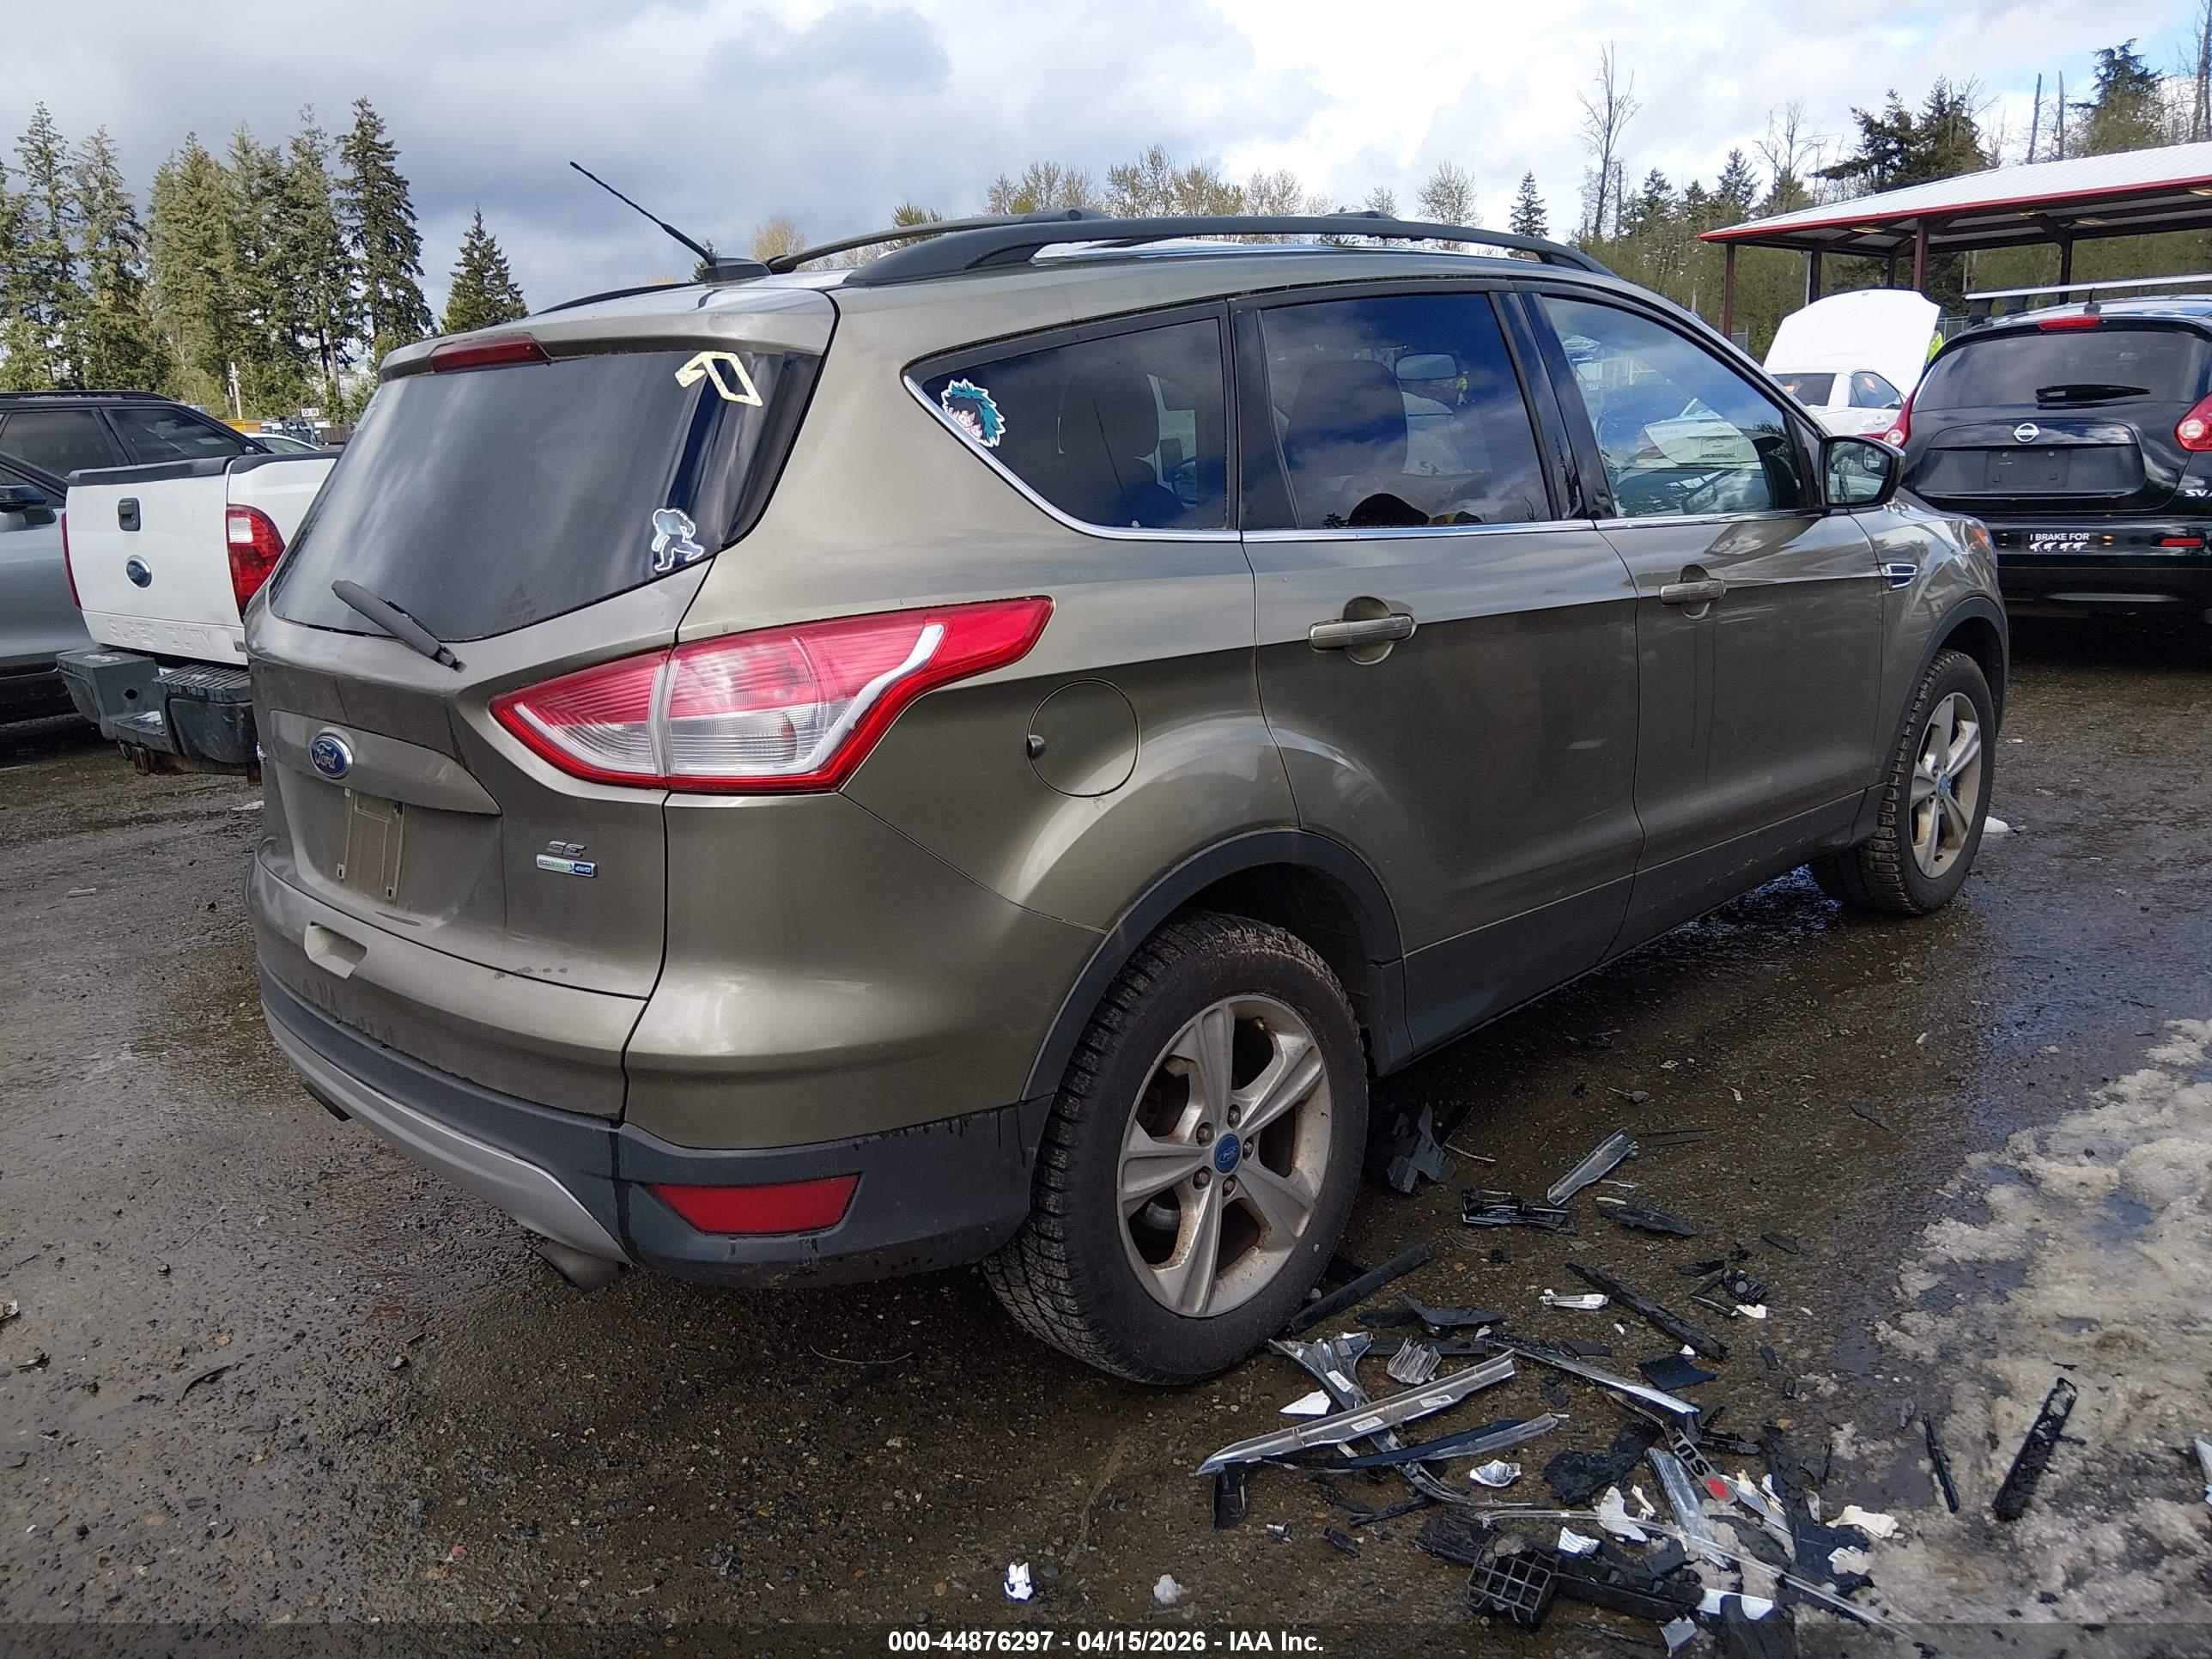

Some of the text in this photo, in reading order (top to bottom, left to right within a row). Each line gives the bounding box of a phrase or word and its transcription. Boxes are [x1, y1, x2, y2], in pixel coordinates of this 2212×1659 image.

[2035, 532, 2068, 541] BRAKE
[2069, 532, 2090, 541] FOR
[107, 619, 214, 653] SUPER DUTY
[545, 840, 587, 858] SE
[574, 865, 591, 873] 4WD
